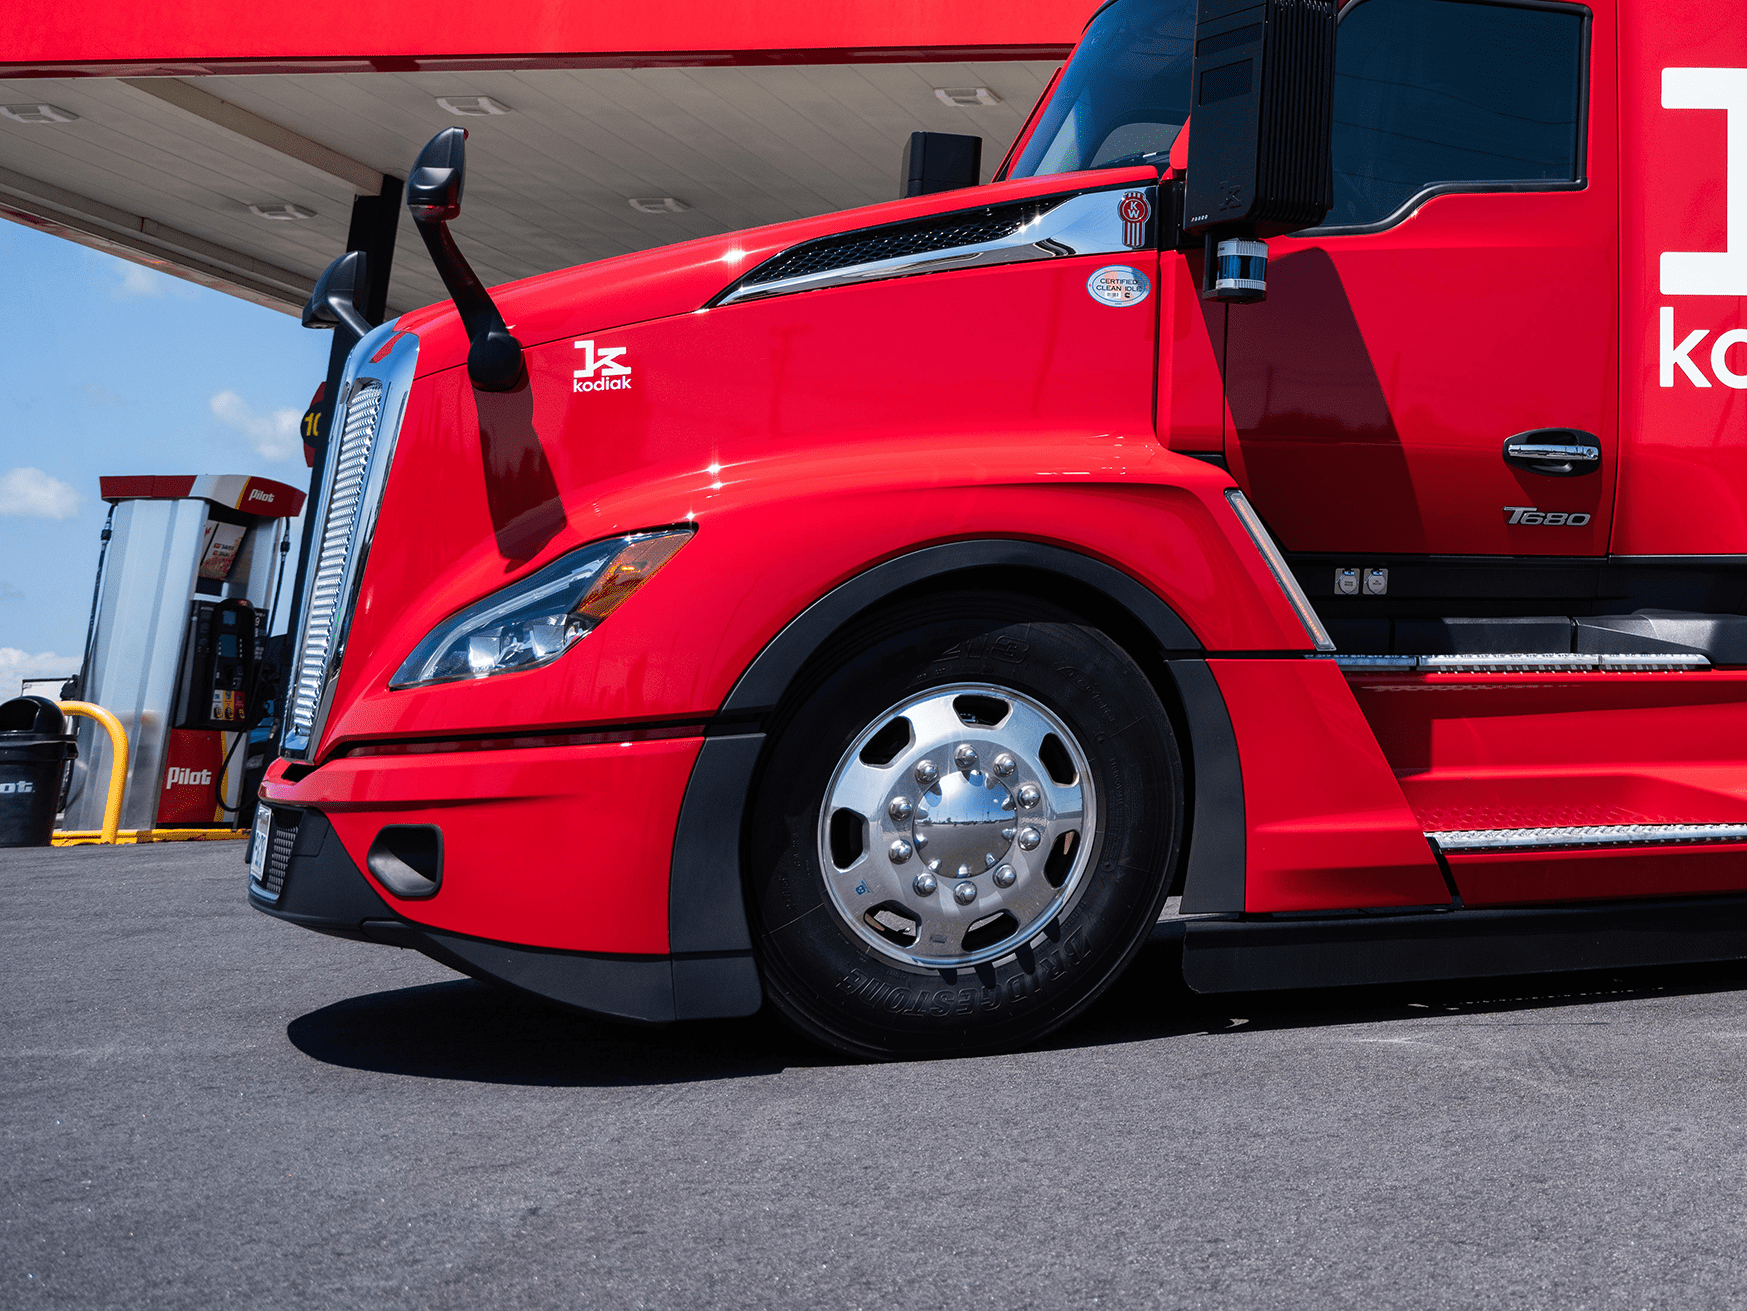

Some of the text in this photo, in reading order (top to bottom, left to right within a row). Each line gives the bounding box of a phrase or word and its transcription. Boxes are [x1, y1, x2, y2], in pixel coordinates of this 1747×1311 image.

[573, 376, 632, 393] kodiak
[248, 489, 275, 502] Pilot
[1503, 506, 1591, 526] T680
[166, 767, 212, 790] Pilot
